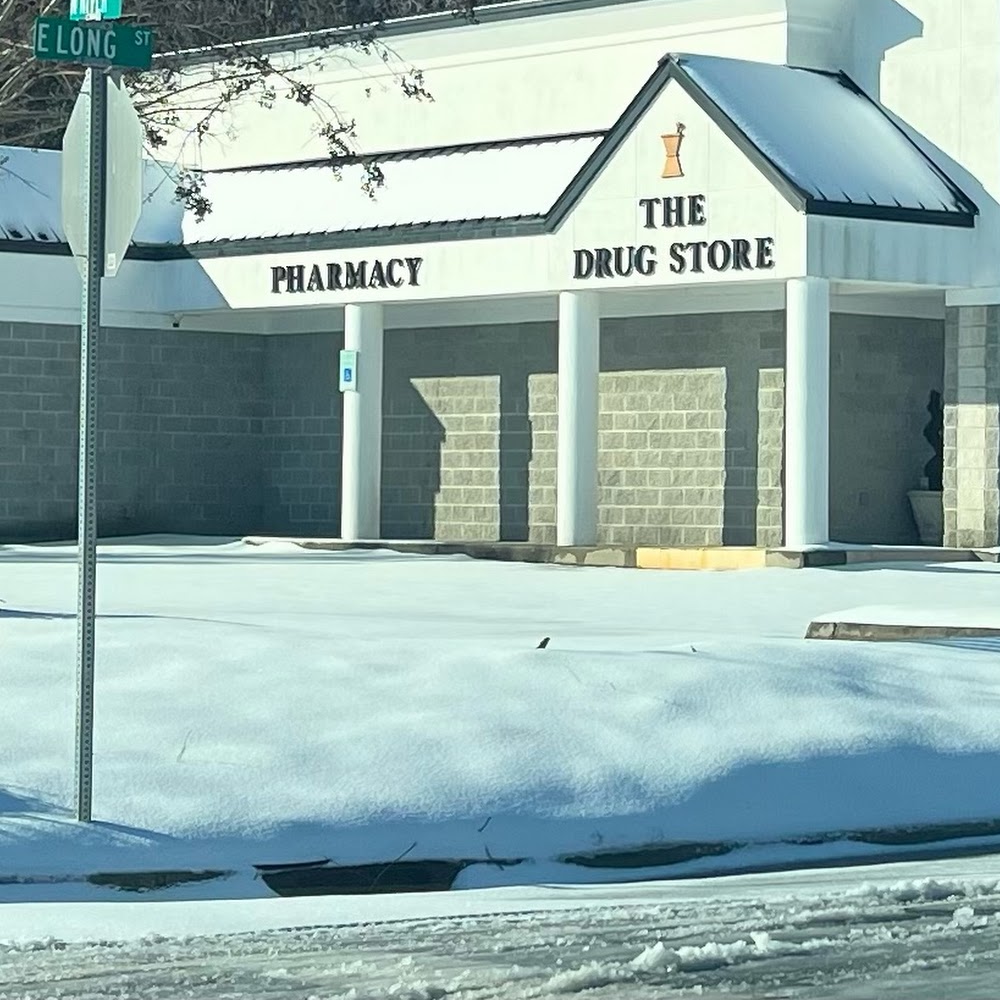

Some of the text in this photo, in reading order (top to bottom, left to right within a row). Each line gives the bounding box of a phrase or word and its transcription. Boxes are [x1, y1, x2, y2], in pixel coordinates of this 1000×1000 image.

[38, 24, 150, 59] E LONG ST
[639, 194, 707, 229] THE
[270, 257, 424, 294] PHARMACY
[572, 237, 775, 280] DRUG STORE
